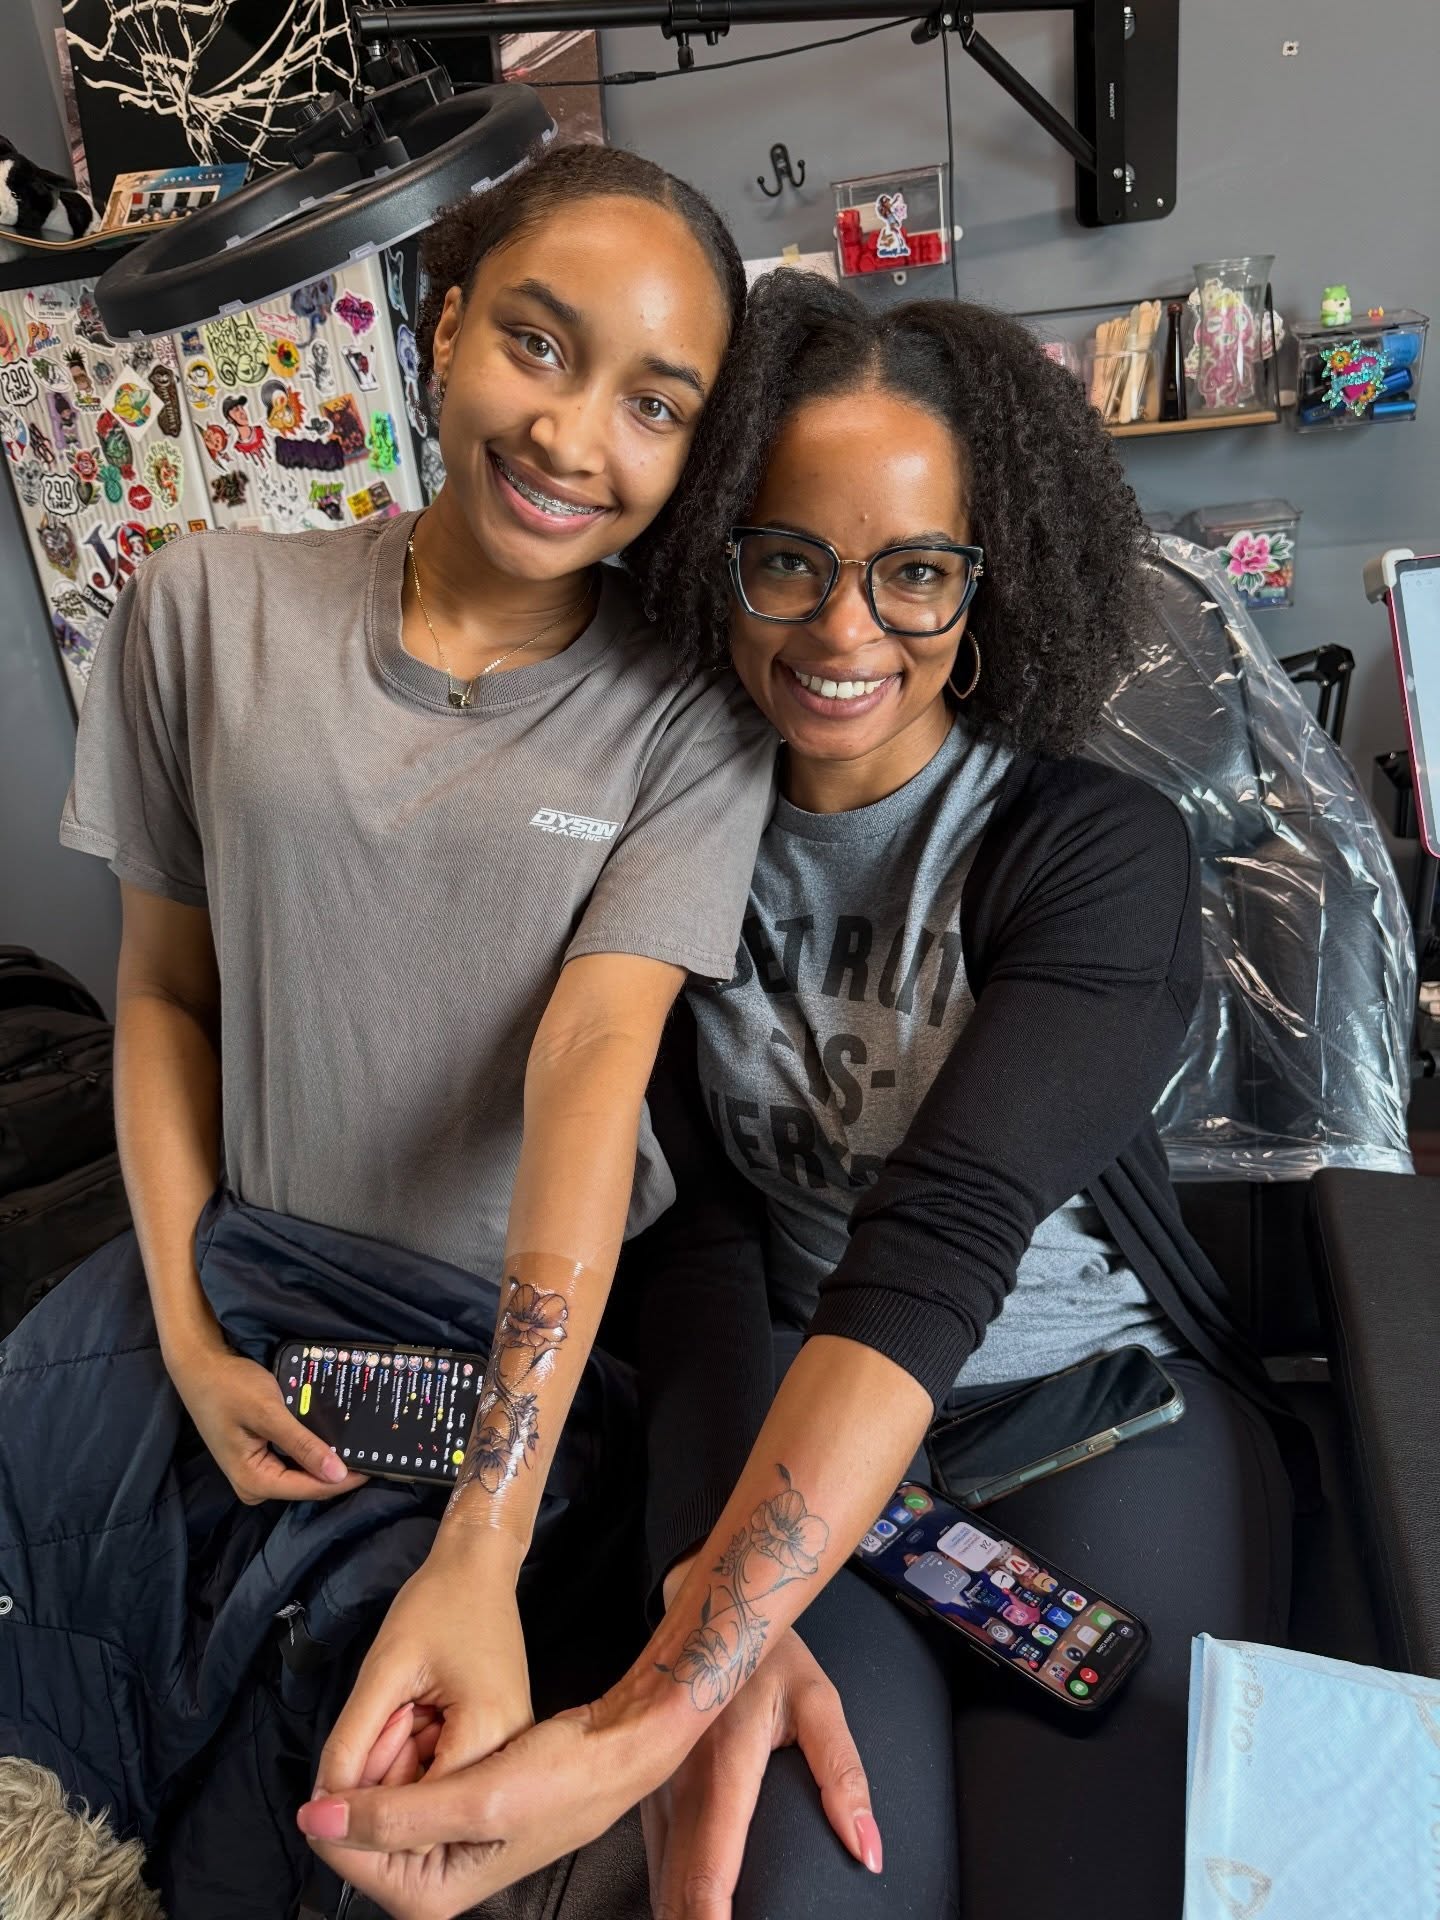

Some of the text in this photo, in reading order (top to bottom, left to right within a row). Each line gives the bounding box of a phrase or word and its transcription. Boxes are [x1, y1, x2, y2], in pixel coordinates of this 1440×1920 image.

[197, 172, 223, 180] CITY
[1, 366, 30, 392] 290
[45, 480, 73, 501] 290
[531, 810, 618, 837] DYSON
